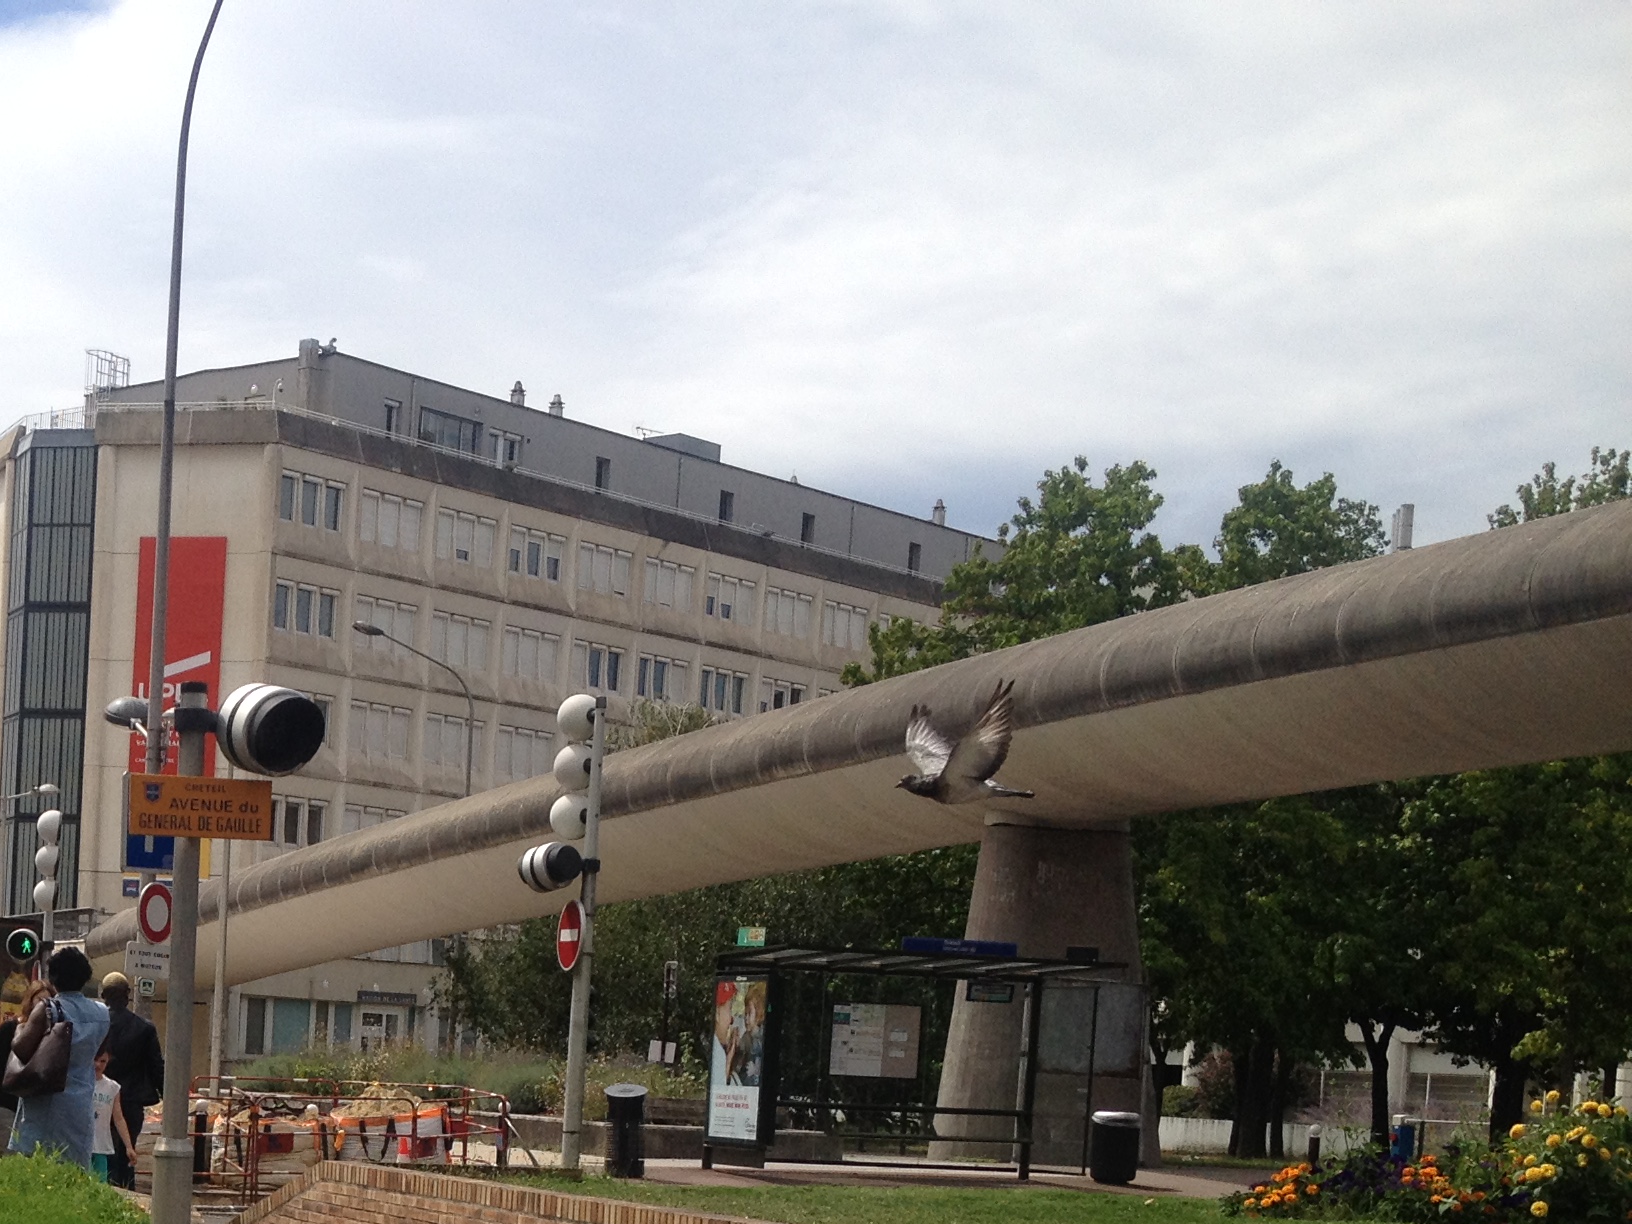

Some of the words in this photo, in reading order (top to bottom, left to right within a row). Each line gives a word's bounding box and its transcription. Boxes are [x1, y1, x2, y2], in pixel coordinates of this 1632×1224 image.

[169, 798, 234, 813] AVENUE
[238, 800, 260, 814] du
[198, 814, 213, 832] DE
[216, 816, 263, 834] GAULLE
